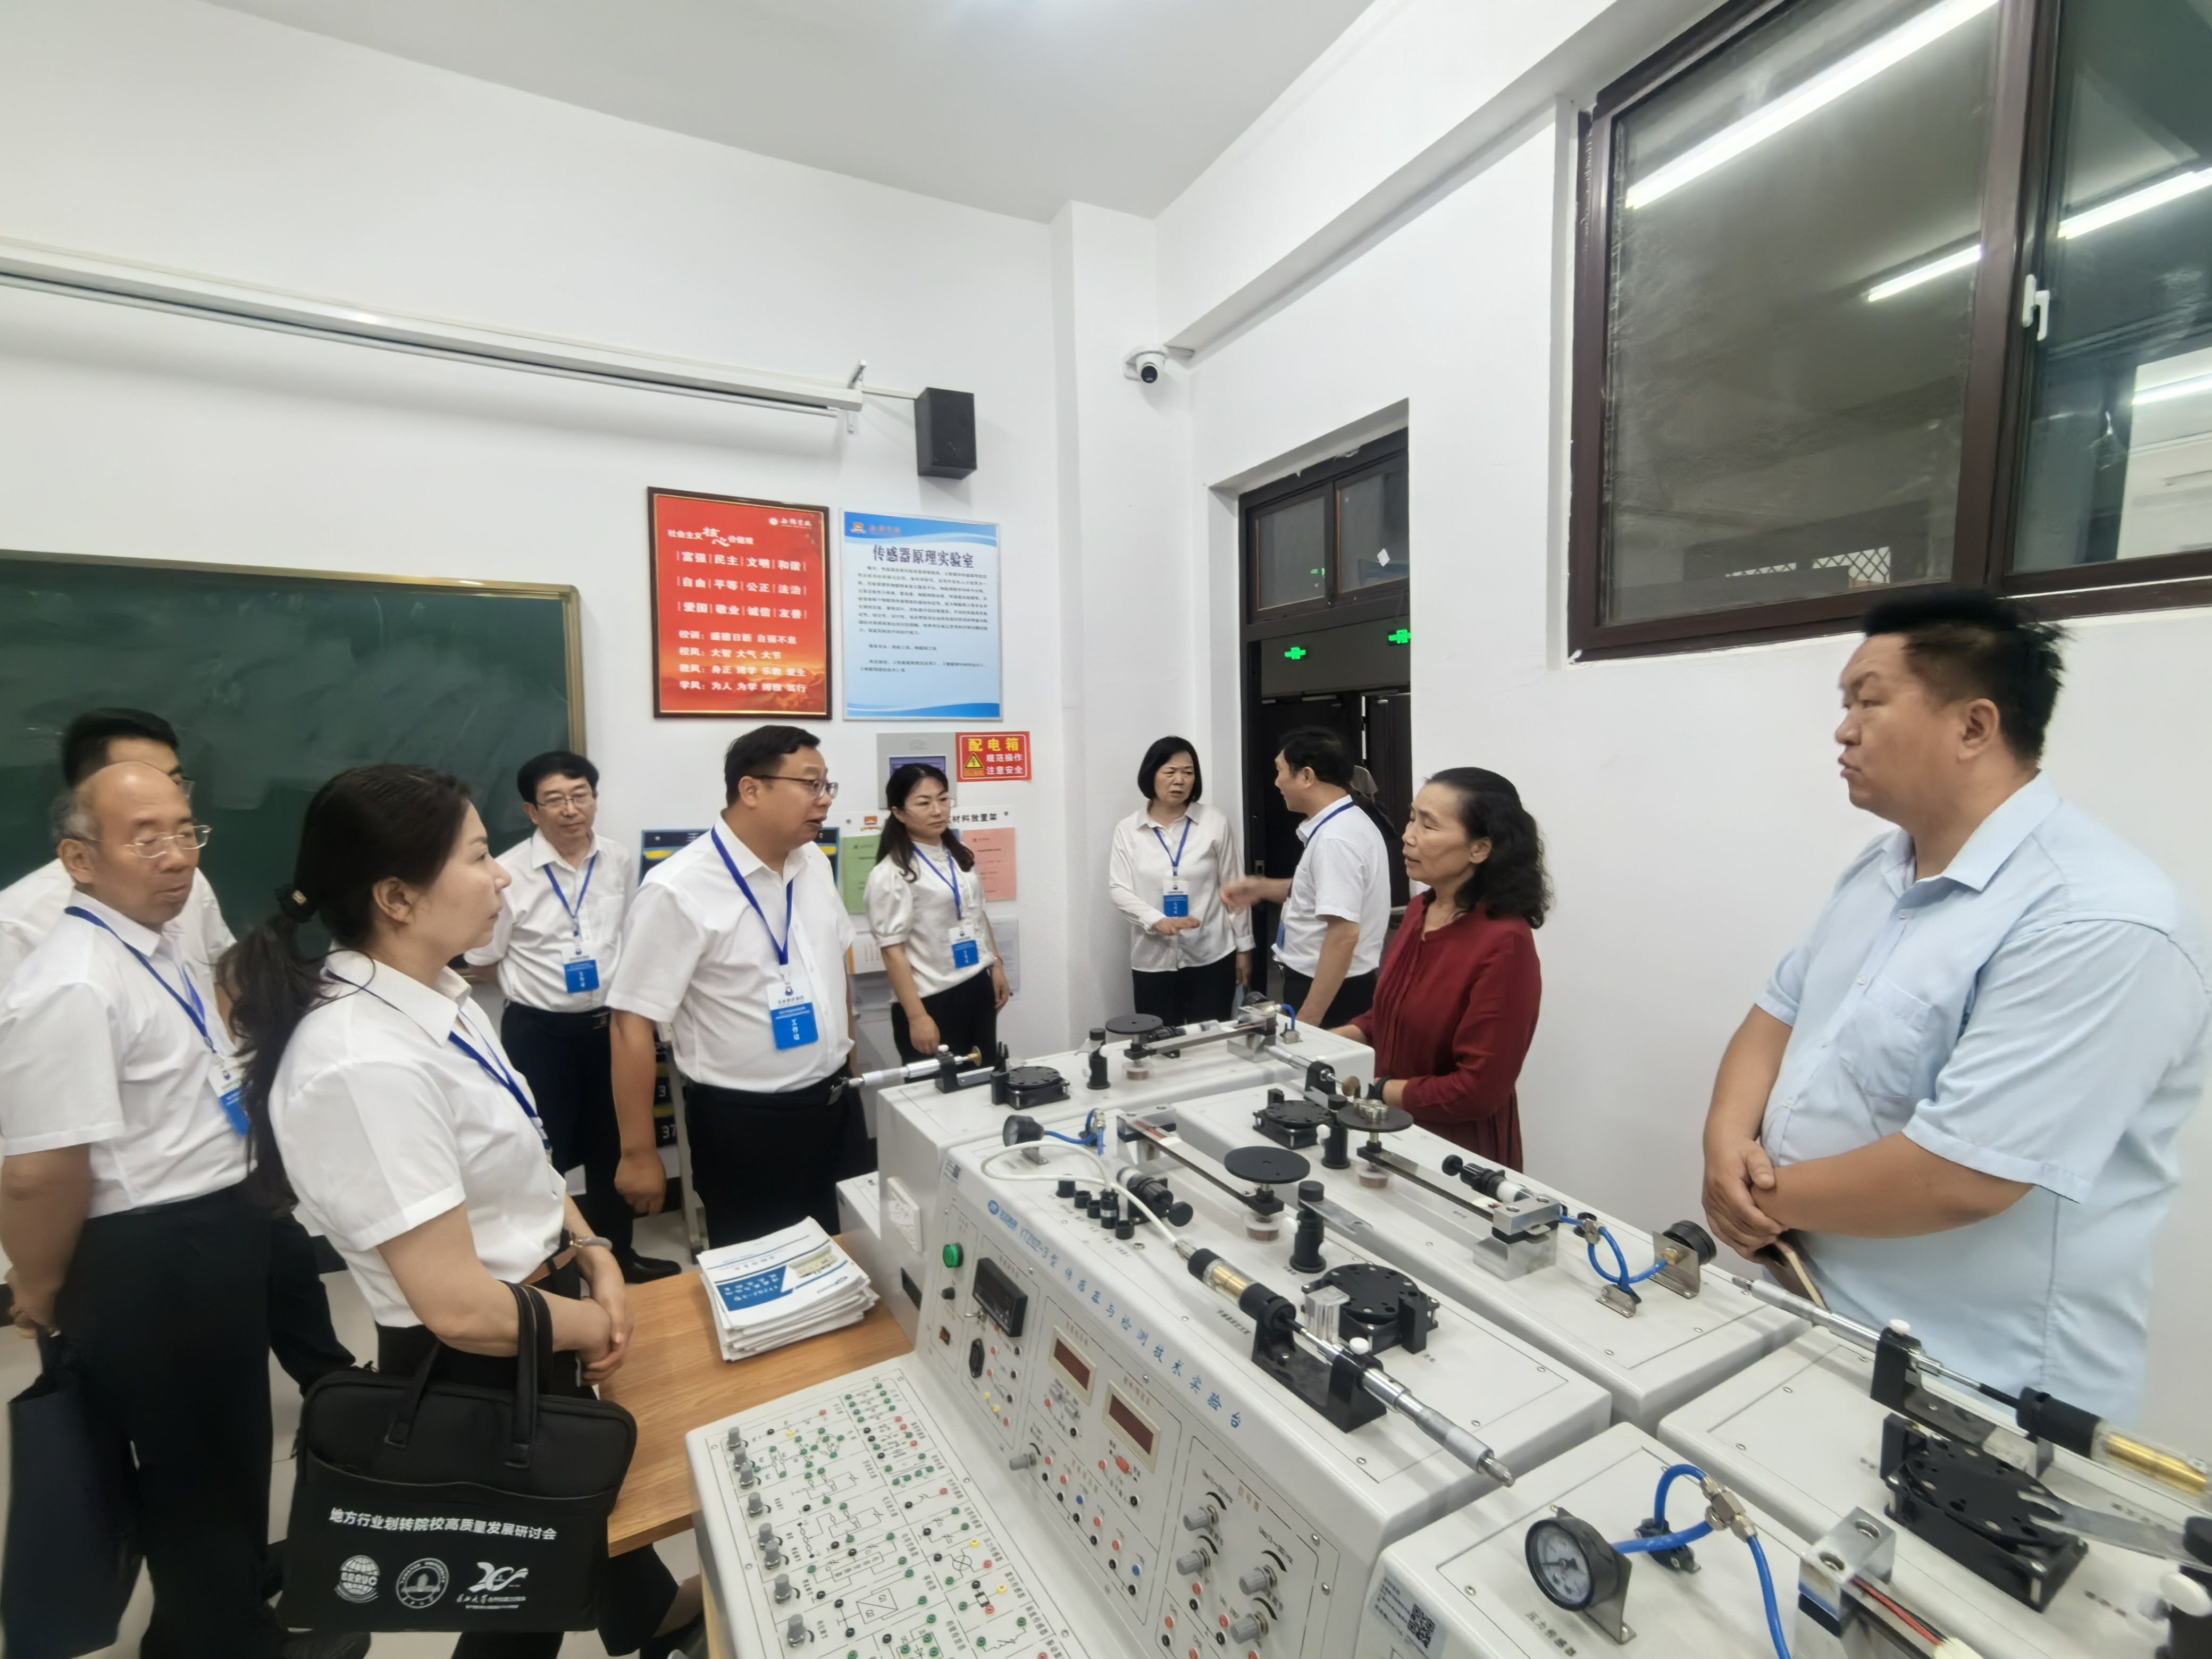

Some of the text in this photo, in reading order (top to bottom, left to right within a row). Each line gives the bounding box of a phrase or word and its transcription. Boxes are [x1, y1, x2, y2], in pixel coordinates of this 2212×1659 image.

[667, 527, 754, 547] 社会主义核心价值观
[682, 551, 801, 571] 富强 民主 文明 和谐
[873, 544, 974, 569] 传感器原理实验室
[683, 577, 801, 595] 自由 平等 公正 法治
[683, 602, 801, 619] 爱国 敬业 诚信 友善
[757, 634, 797, 644] 自强不息
[736, 650, 757, 659] 大气
[761, 651, 782, 659] 大节
[711, 665, 732, 674] 身正
[711, 681, 732, 690] 为人
[968, 738, 1019, 752] 配电箱
[986, 753, 1023, 762] 规范操作
[986, 765, 1023, 775] 注意安全
[329, 1507, 557, 1540] 地方行业划转院校高质量发展研讨会
